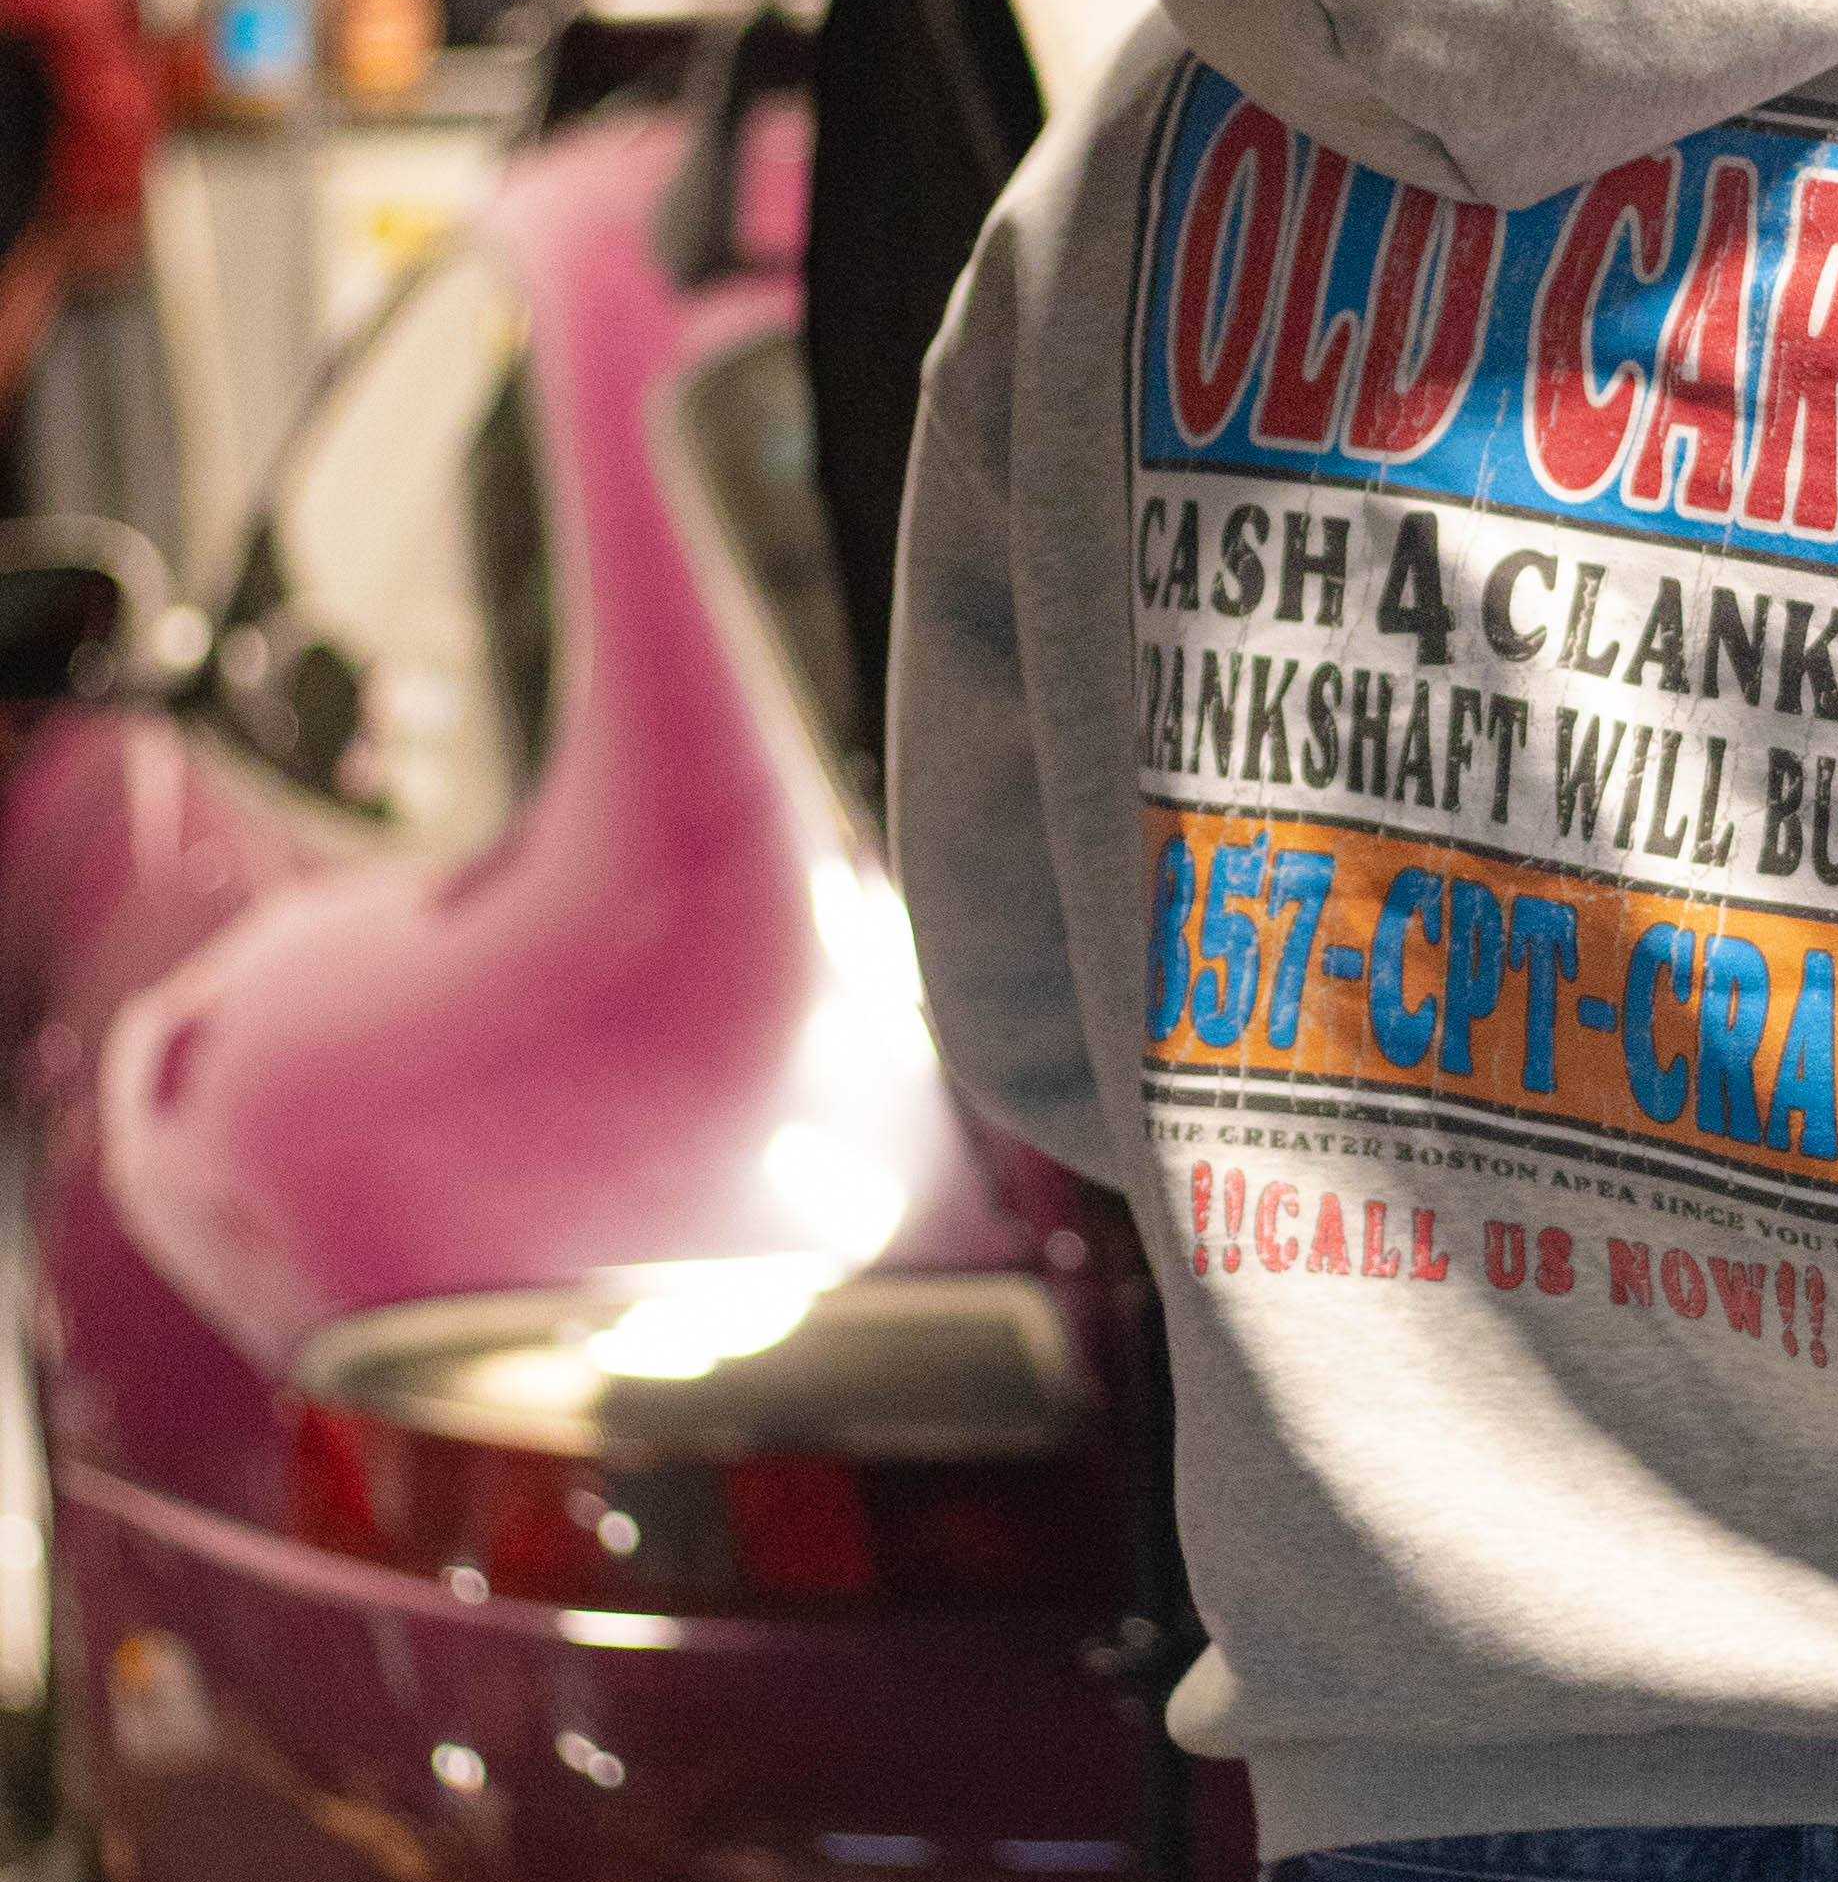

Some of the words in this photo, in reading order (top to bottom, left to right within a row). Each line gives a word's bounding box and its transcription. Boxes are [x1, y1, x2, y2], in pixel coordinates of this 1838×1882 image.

[1167, 98, 1507, 464] OLD
[1138, 494, 1352, 628] CASH
[1377, 510, 1456, 666] 4
[1555, 705, 1736, 868] WILL
[1191, 1159, 1450, 1282] !!CALL
[1483, 1219, 1576, 1295] US
[1606, 1236, 1829, 1368] NOW!!
[1754, 1217, 1823, 1251] YOU
